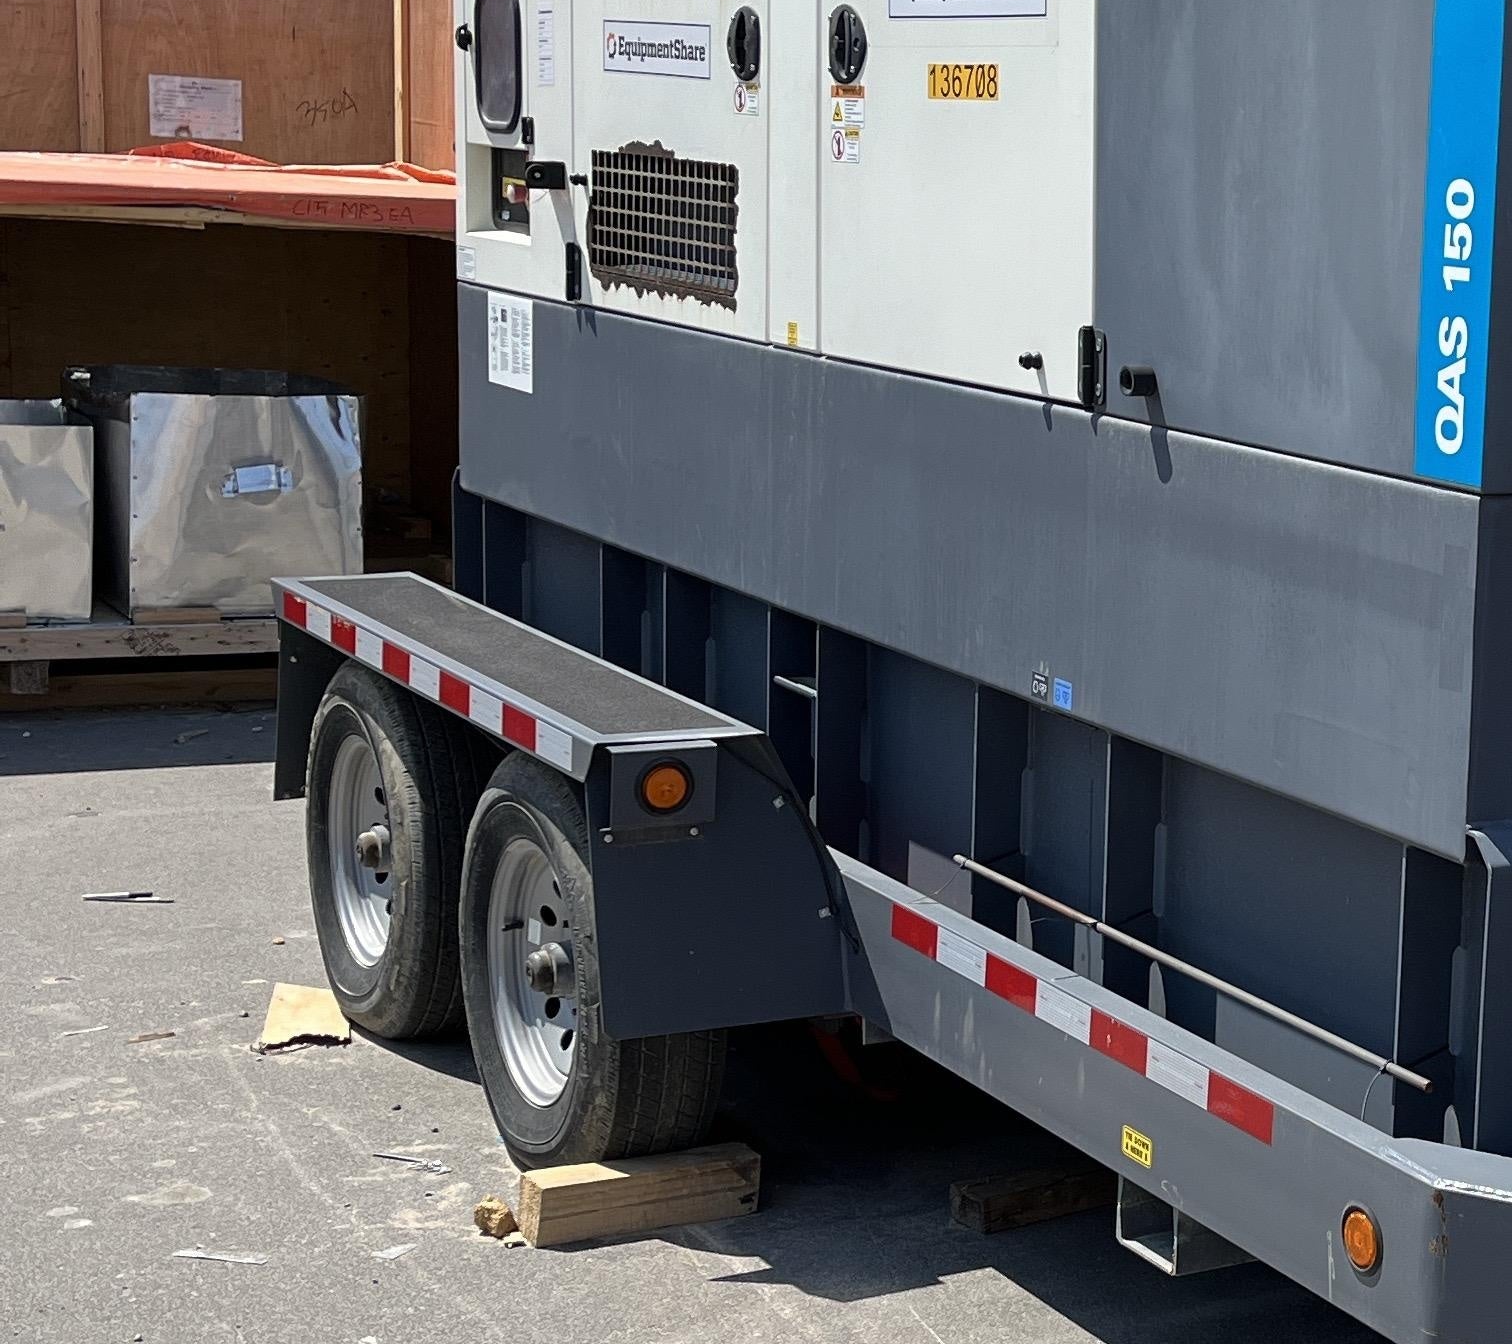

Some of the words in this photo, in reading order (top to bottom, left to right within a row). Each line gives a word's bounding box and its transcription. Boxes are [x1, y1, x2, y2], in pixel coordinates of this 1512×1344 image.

[618, 35, 706, 62] EquipmentShare
[929, 64, 998, 98] 136708
[1442, 178, 1475, 292] 150
[1434, 315, 1468, 455] QAS
